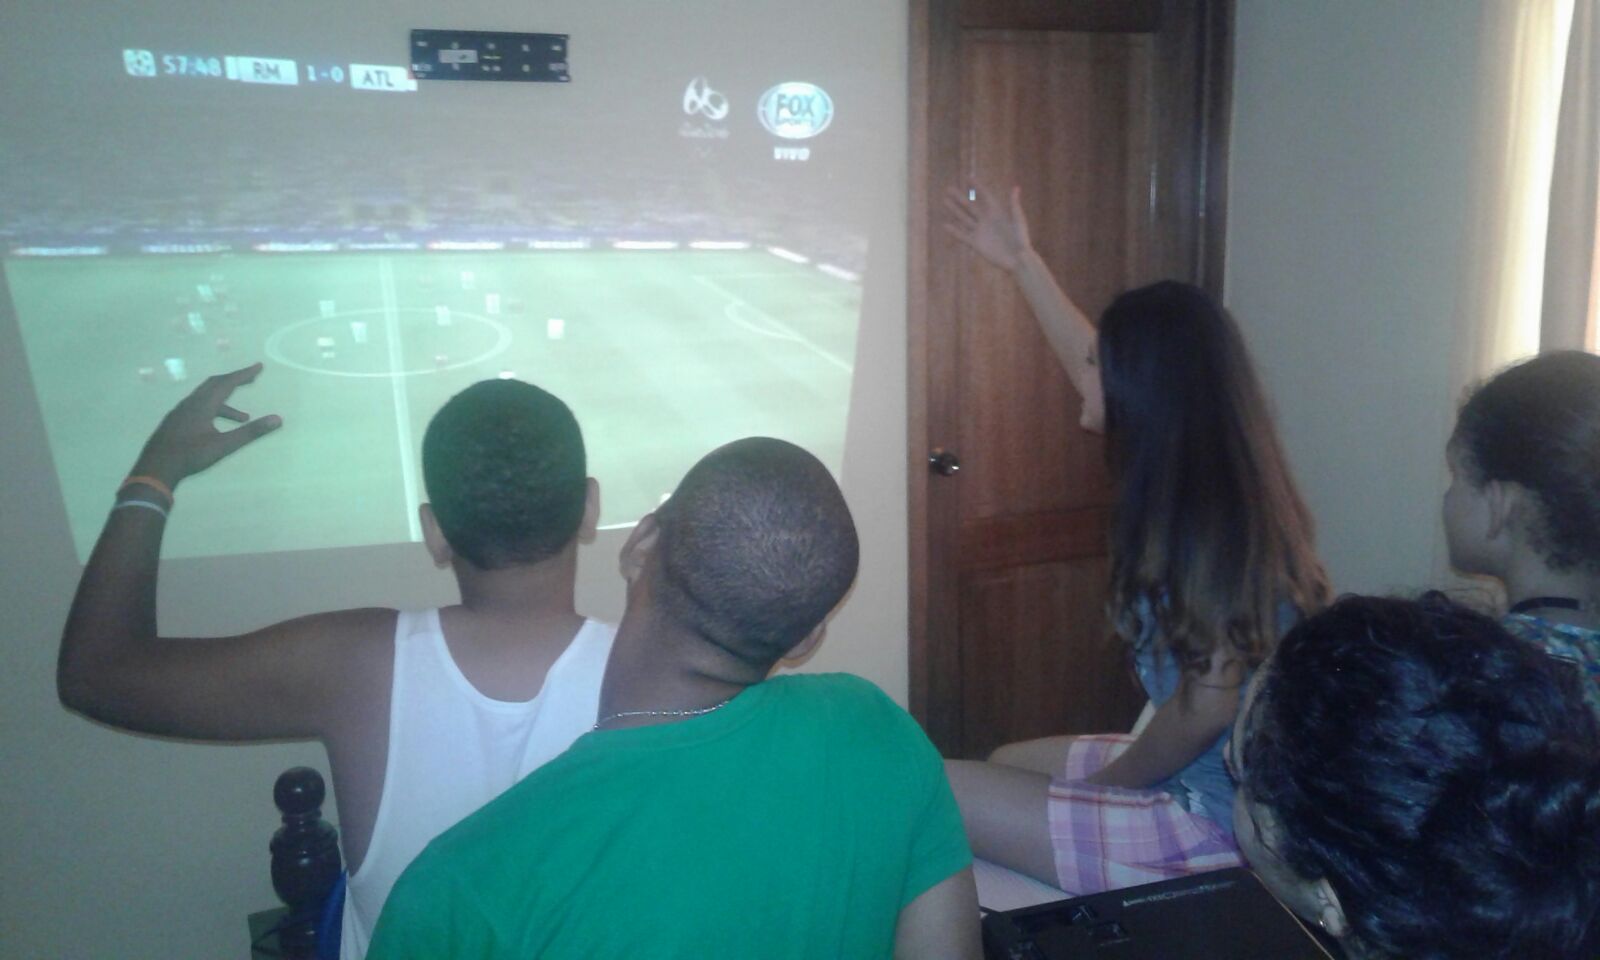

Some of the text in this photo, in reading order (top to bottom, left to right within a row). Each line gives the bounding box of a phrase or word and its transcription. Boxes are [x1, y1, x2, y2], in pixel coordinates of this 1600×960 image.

[253, 60, 281, 80] RM
[361, 69, 394, 87] ATL
[776, 93, 814, 117] FOX
